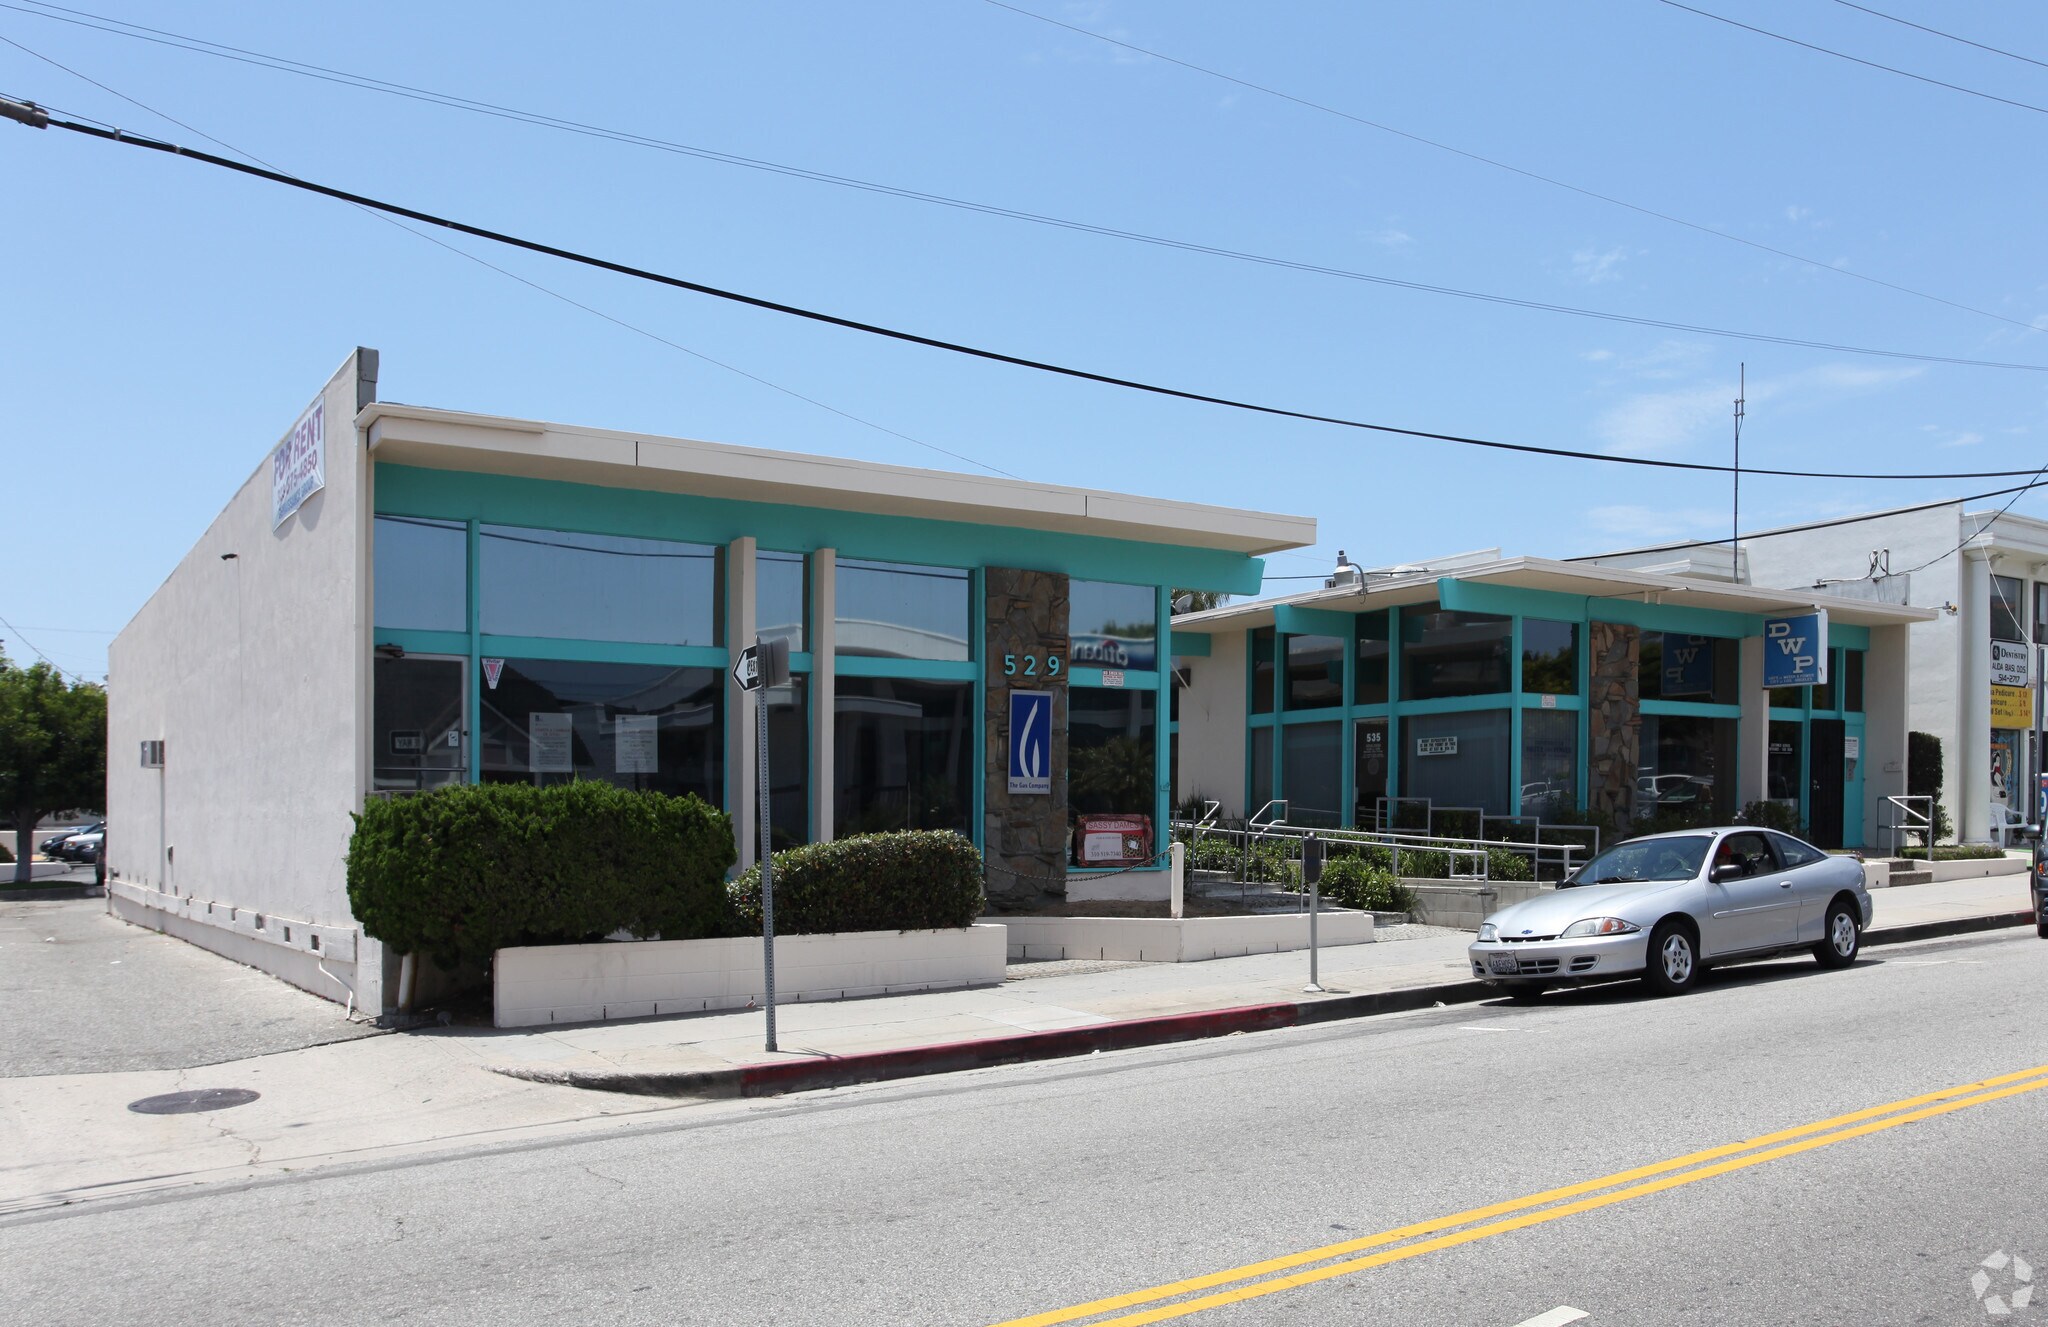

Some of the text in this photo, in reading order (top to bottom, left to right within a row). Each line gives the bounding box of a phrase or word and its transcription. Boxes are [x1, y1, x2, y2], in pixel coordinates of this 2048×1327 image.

[274, 404, 322, 486] FOR RENT
[1004, 655, 1060, 676] 529
[1366, 732, 1381, 742] 535
[1088, 821, 1139, 829] SASSY DAMES
